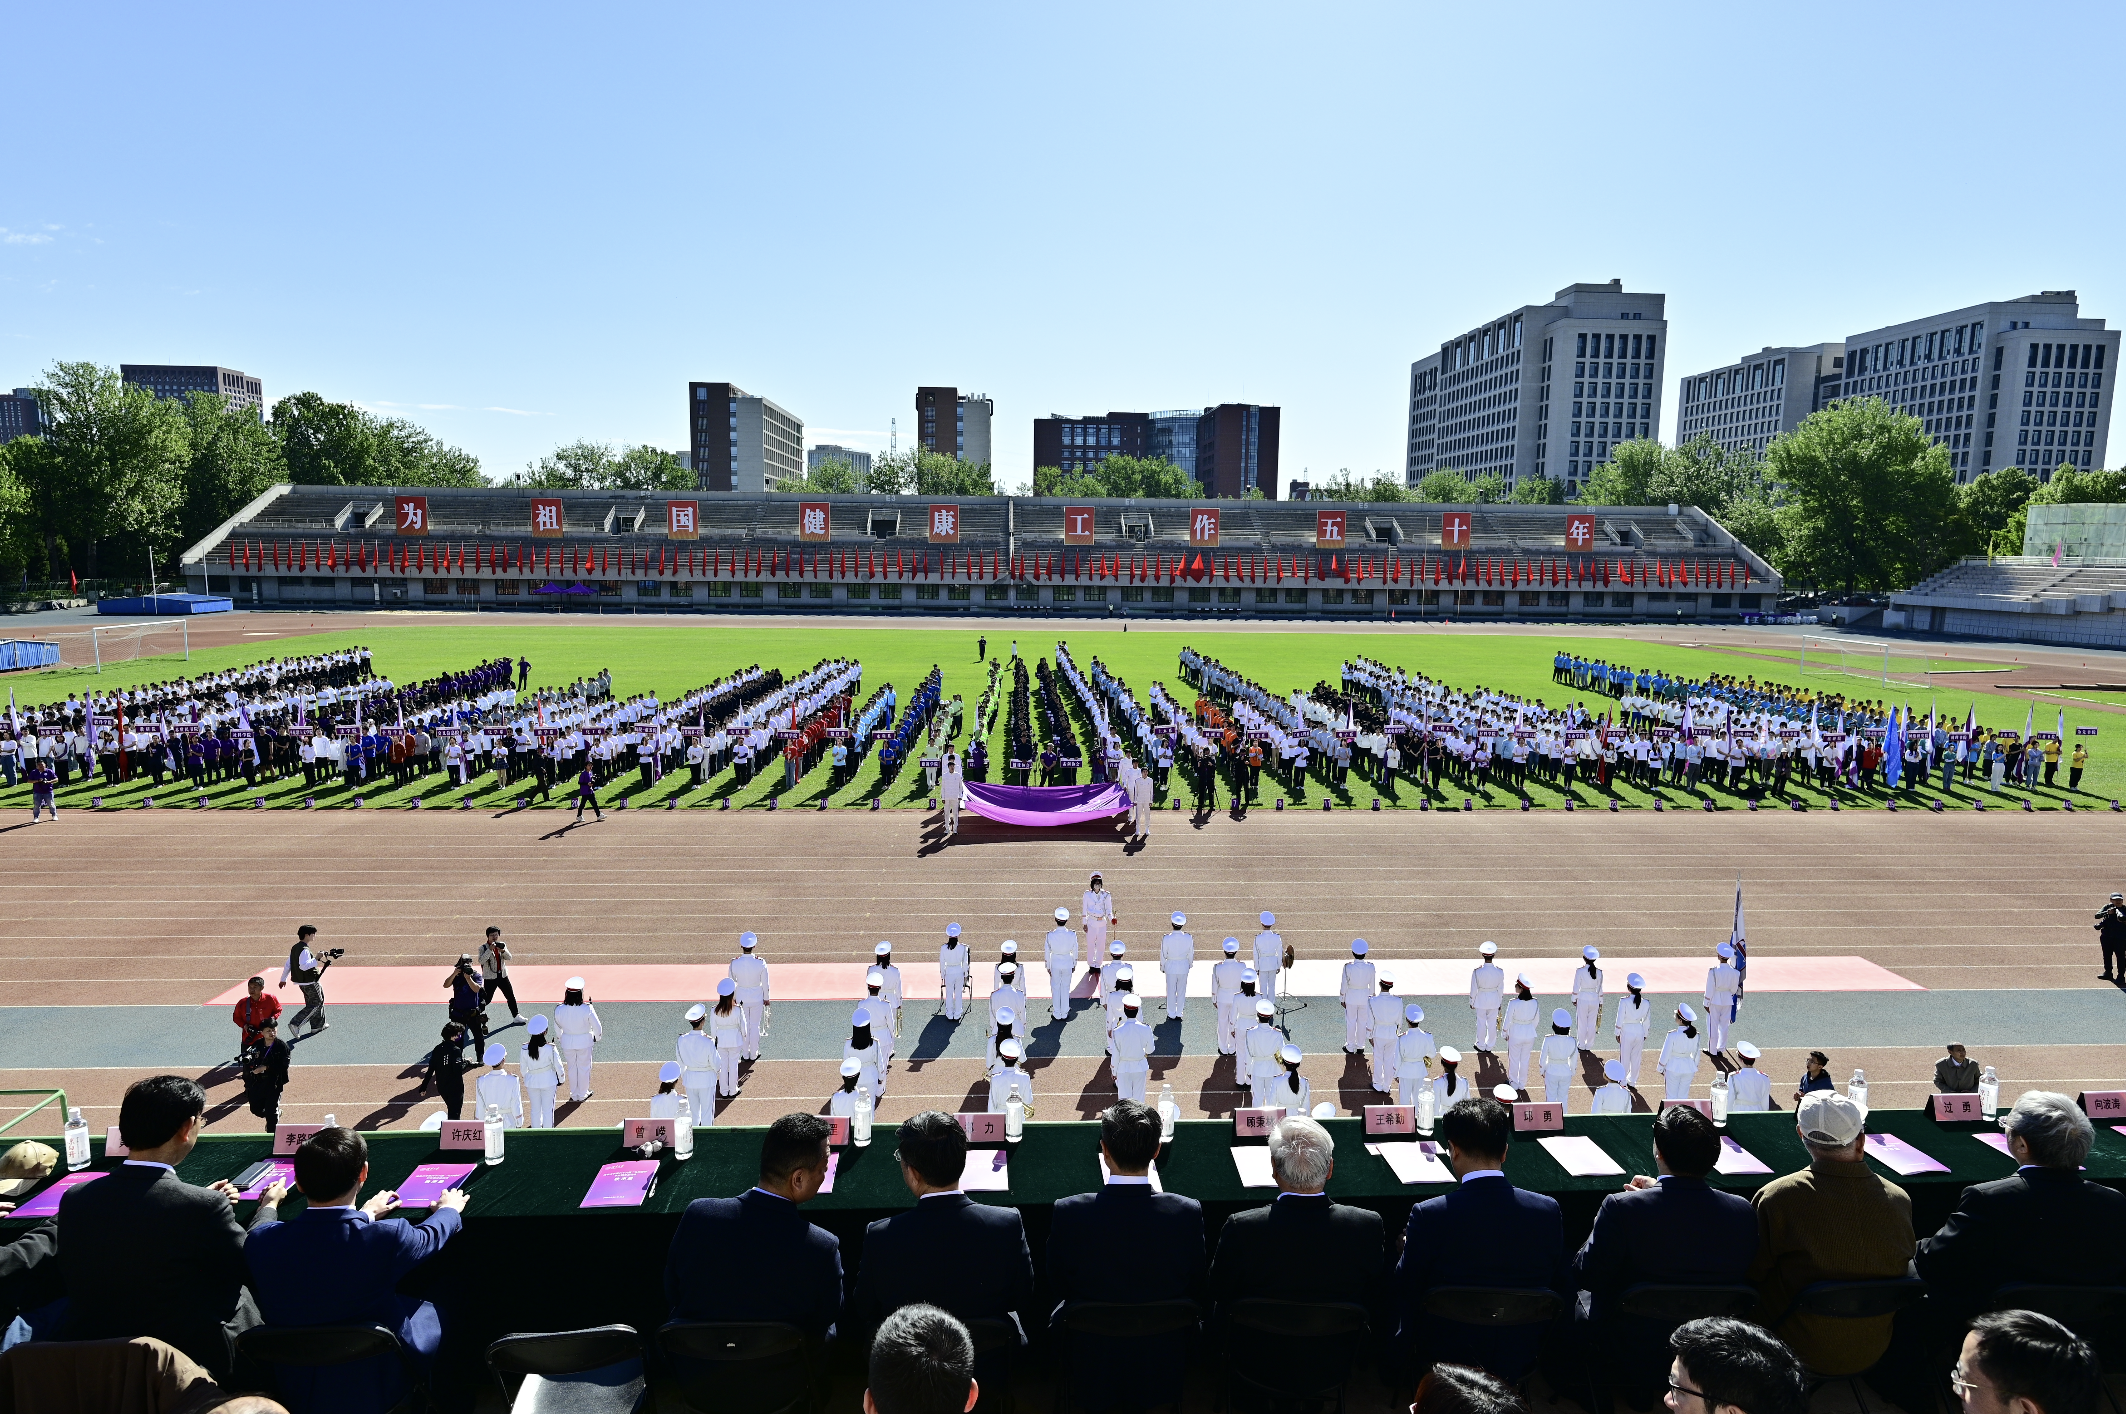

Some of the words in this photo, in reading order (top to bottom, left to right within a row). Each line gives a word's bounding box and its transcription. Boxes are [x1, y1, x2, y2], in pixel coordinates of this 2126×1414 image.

[401, 503, 422, 529] 为
[536, 505, 559, 530] 祖
[672, 507, 693, 532] 国
[804, 509, 825, 534] 健
[933, 510, 955, 535] 康
[1069, 514, 1090, 535] 工
[1194, 515, 1215, 540] 作
[1320, 517, 1341, 539] 五
[1446, 518, 1467, 543] 十
[1569, 520, 1590, 545] 年
[518, 798, 525, 806] 22
[571, 799, 578, 807] 20
[723, 799, 729, 807] 14
[771, 799, 777, 807] 12
[821, 799, 828, 807] 10
[873, 799, 878, 808] 8
[930, 799, 935, 807] 6
[1277, 800, 1282, 808] 9
[1373, 800, 1379, 808] 13
[1421, 800, 1428, 808] 15
[1465, 800, 1471, 808] 17
[1522, 800, 1529, 808] 19
[1566, 800, 1573, 808] 21
[1655, 800, 1662, 808] 25
[1943, 1101, 1971, 1114] 过勇
[2094, 1097, 2121, 1111] 向波涛
[1376, 1113, 1405, 1126] 王希勤
[1523, 1110, 1552, 1123] 邱勇
[1246, 1116, 1276, 1128] 顾秉林
[452, 1128, 483, 1142] 许庆红
